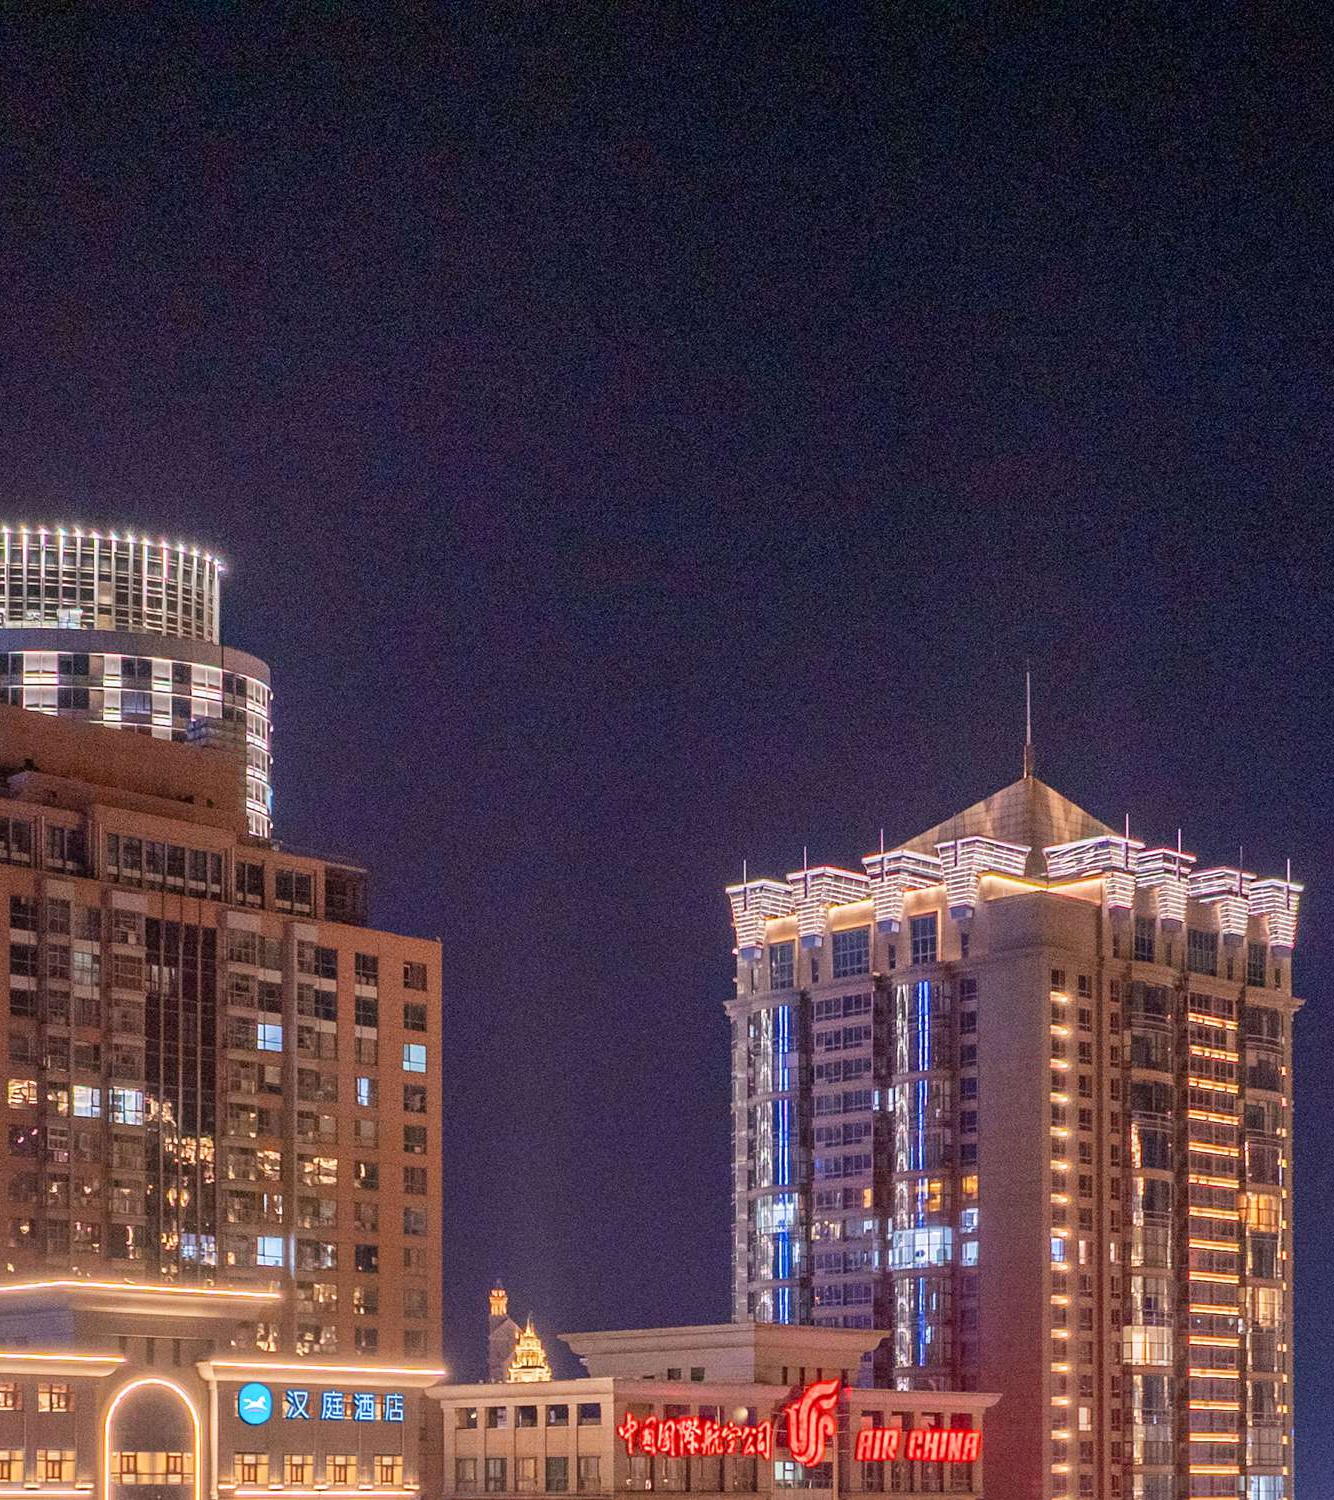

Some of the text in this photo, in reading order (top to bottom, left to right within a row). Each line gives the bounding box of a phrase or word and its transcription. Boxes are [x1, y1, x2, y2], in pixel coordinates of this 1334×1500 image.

[286, 1390, 405, 1422] 汉庭酒店
[855, 1428, 982, 1461] AIR CHINA
